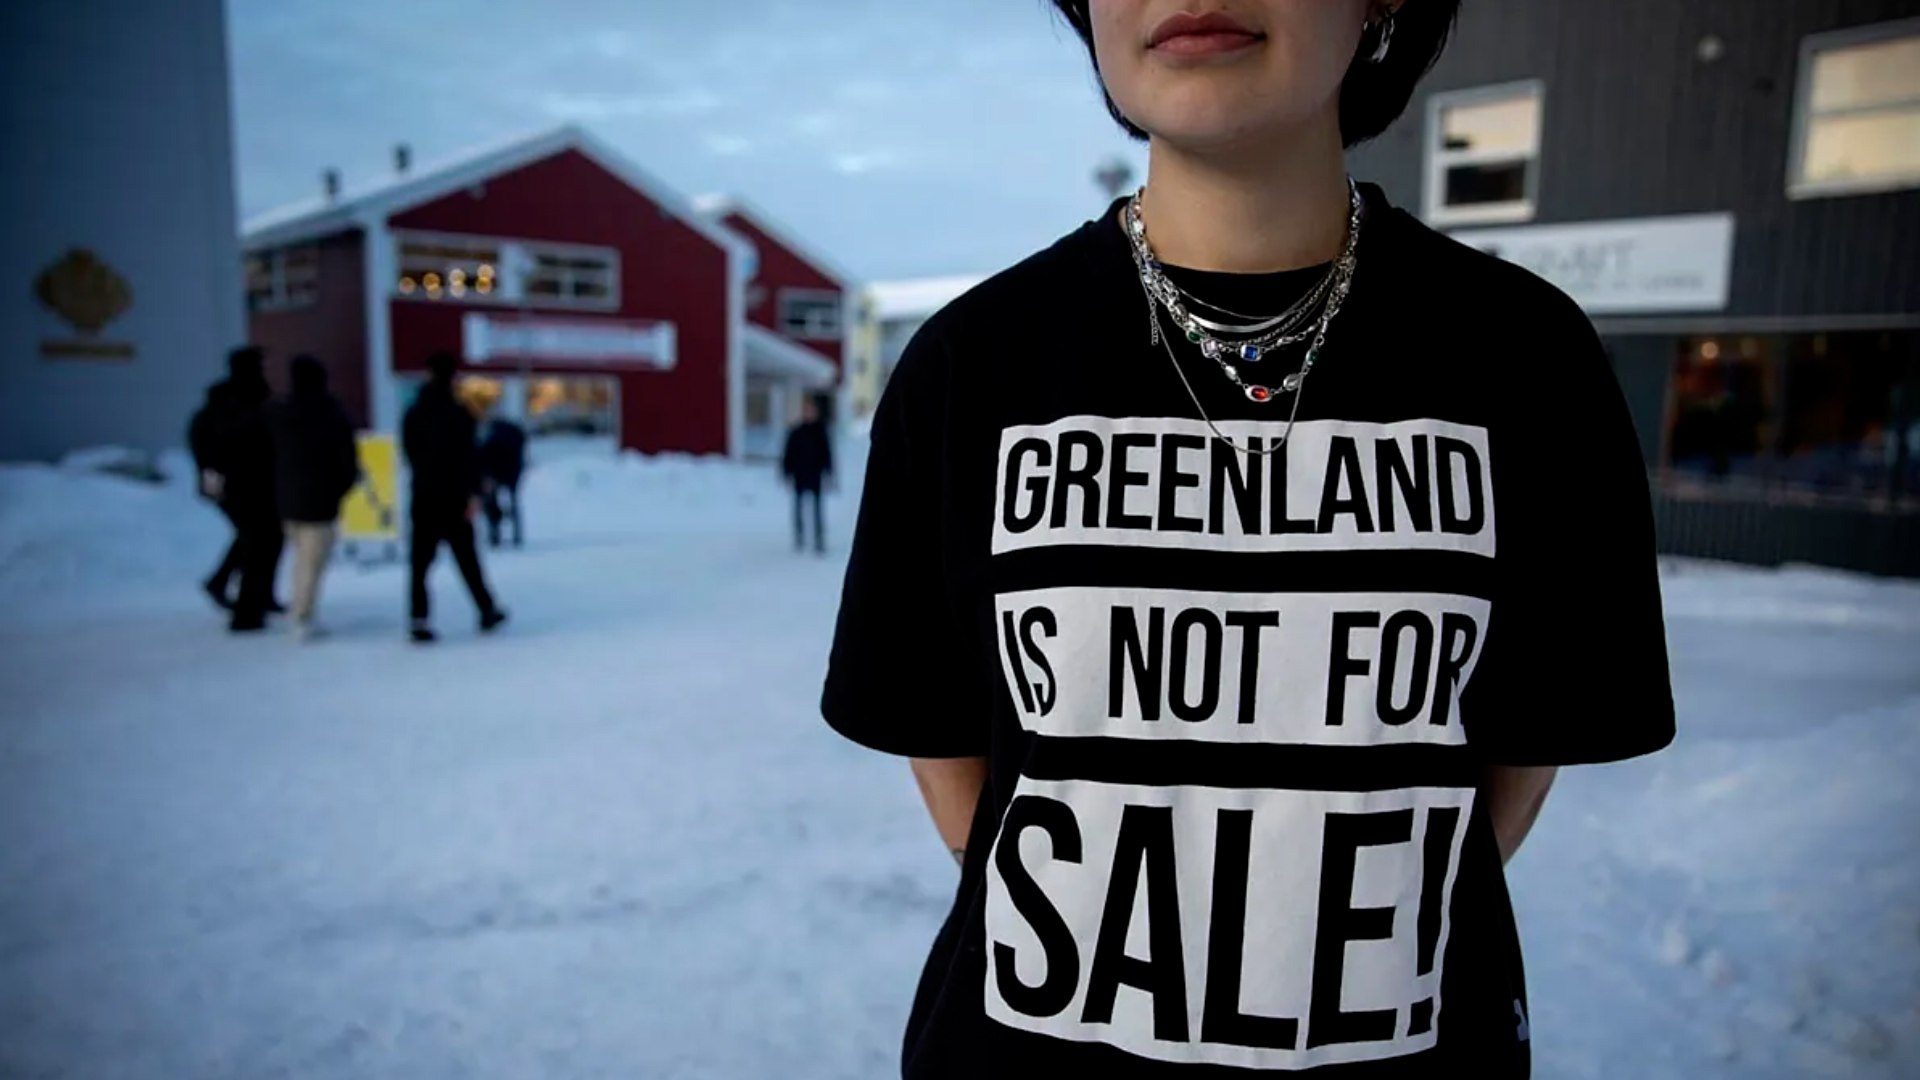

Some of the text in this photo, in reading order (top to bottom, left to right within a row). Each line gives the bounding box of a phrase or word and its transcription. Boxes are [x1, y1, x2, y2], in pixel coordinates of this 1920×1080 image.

[1002, 430, 1486, 536] GREENLAND
[1003, 605, 1478, 727] IS NOT FOR
[993, 794, 1462, 1051] SALE!
